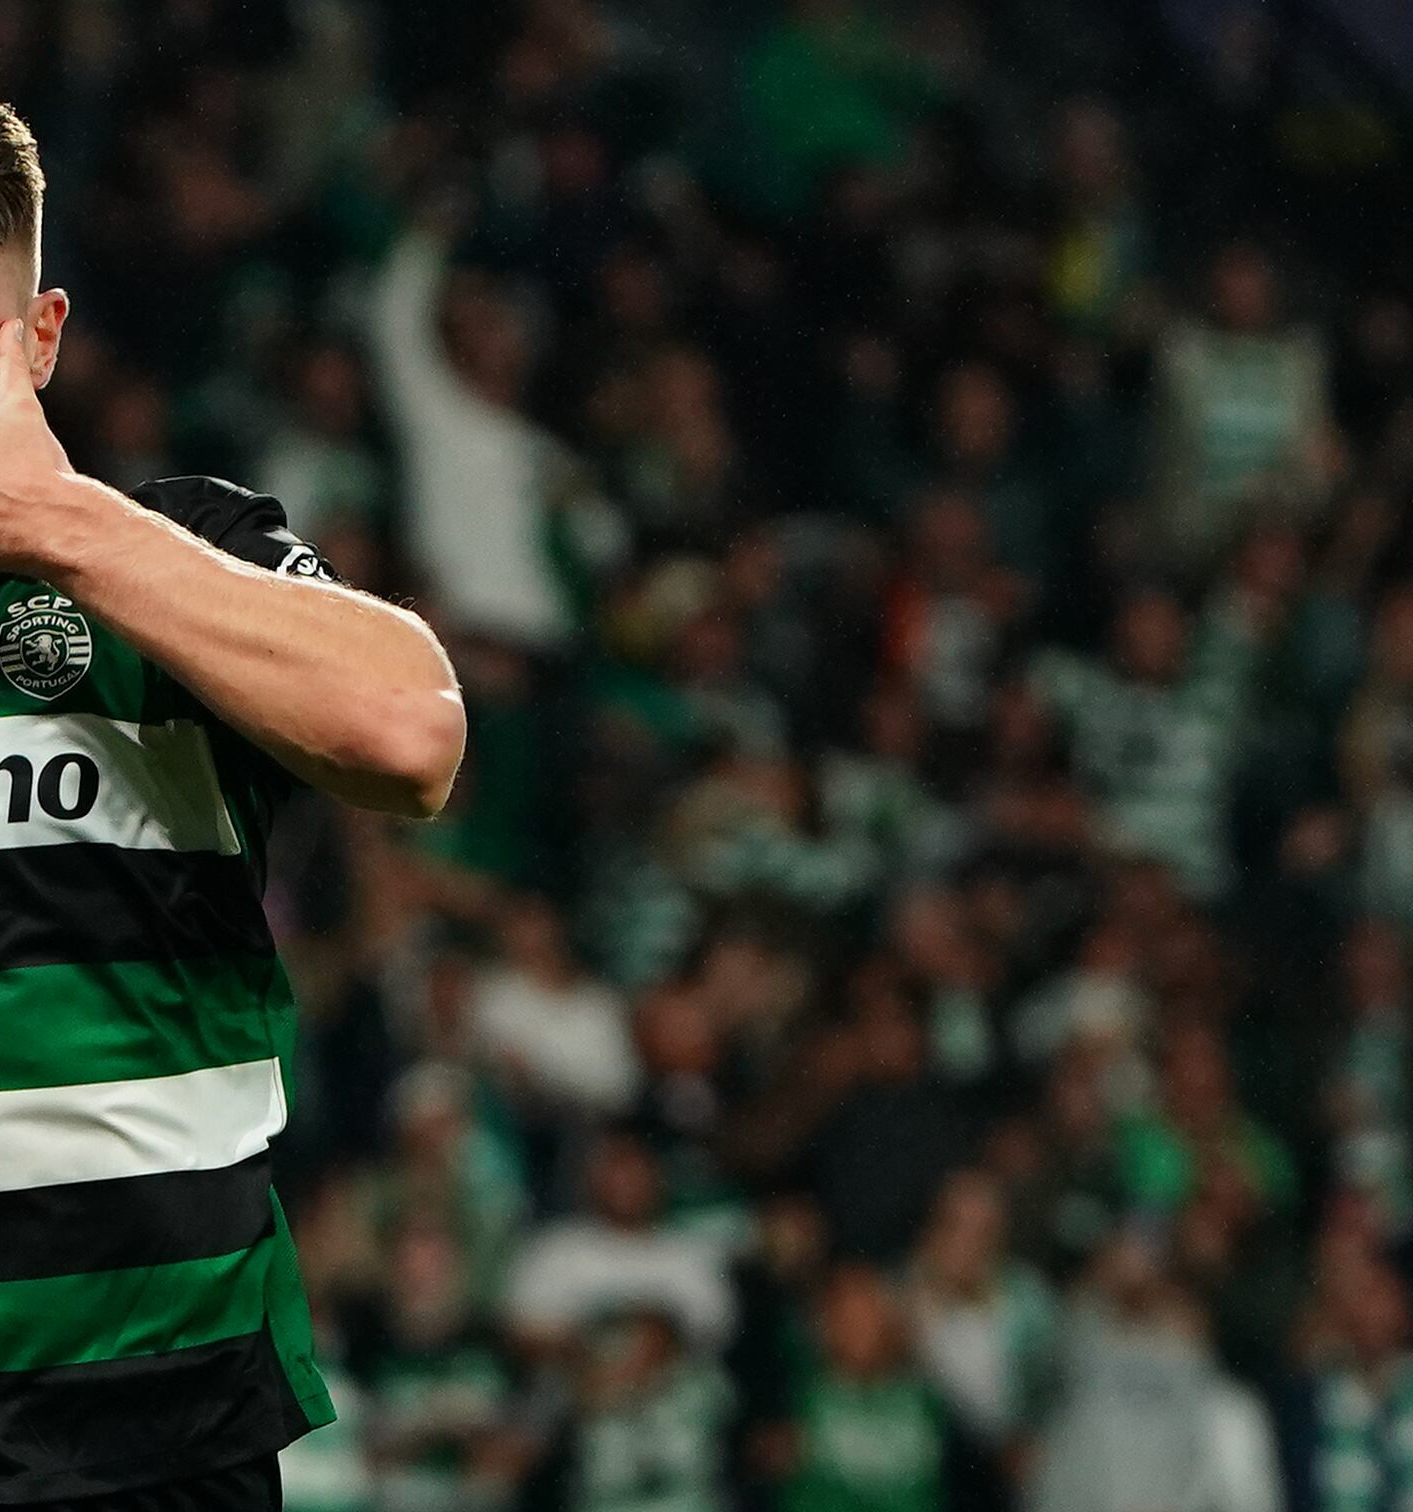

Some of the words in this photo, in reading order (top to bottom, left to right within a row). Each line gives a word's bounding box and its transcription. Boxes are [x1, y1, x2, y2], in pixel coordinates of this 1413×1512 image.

[7, 595, 73, 617] SCP
[6, 615, 80, 641] SPORTING
[15, 669, 81, 689] PORTUGAL
